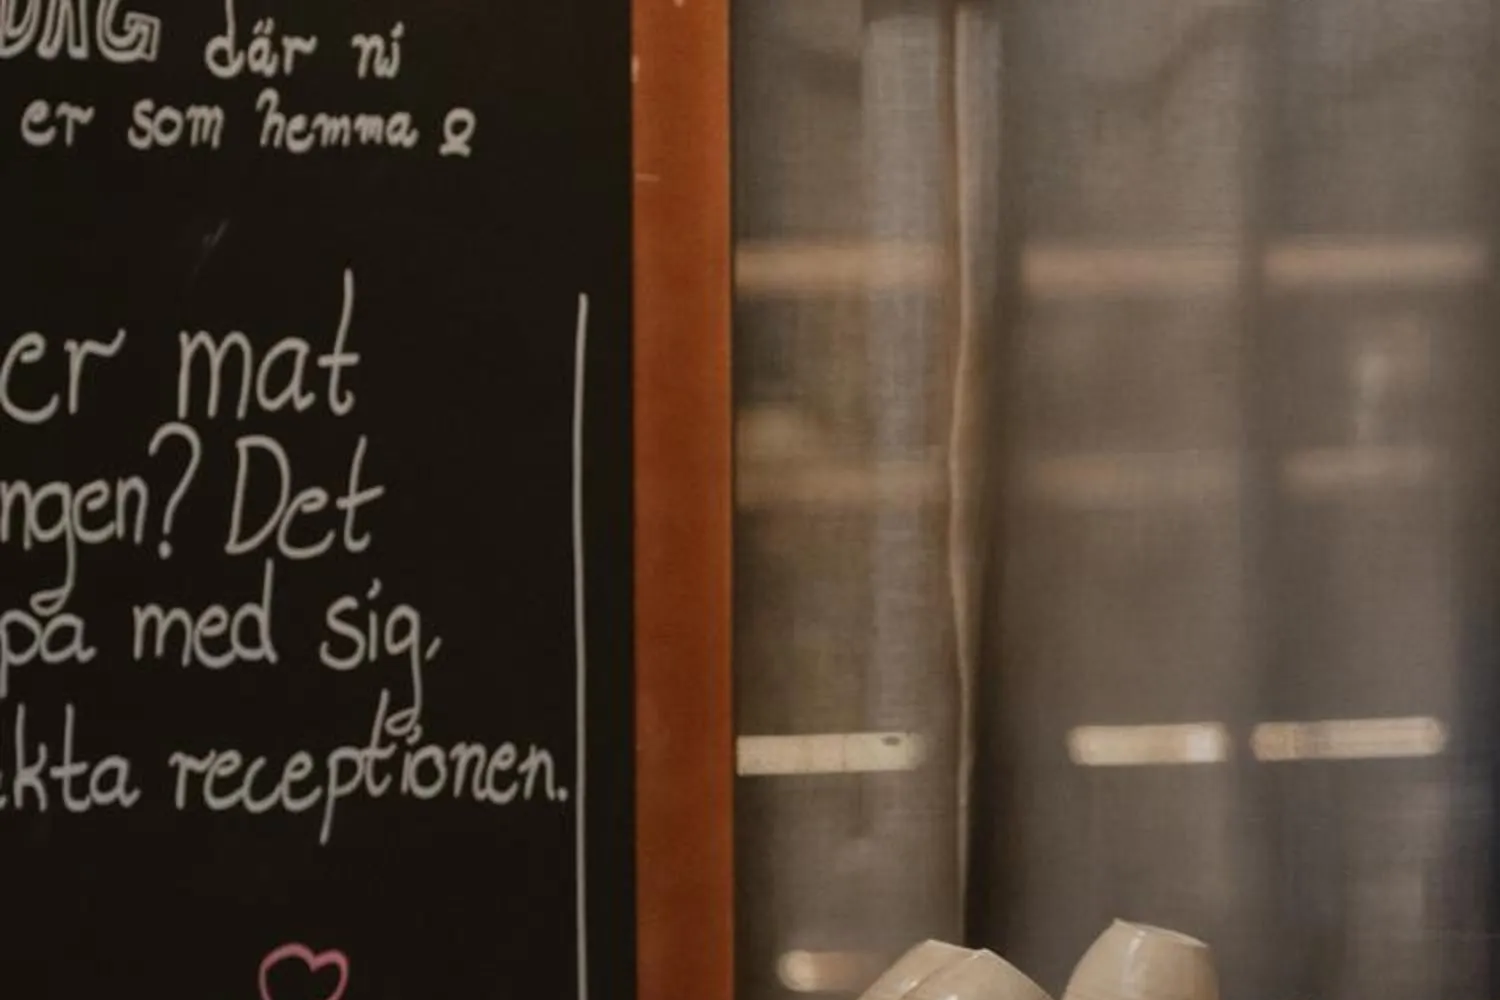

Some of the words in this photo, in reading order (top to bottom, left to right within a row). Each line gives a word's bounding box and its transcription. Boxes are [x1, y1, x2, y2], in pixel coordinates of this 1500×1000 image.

[205, 0, 318, 79] där
[352, 21, 405, 79] ni
[21, 99, 94, 146] er
[128, 98, 224, 150] som
[256, 87, 419, 153] hemma
[0, 329, 126, 423] er
[178, 268, 360, 419] mat
[225, 436, 384, 558] Det
[133, 559, 278, 668] med
[320, 578, 441, 737] sig,
[0, 704, 140, 812] kta
[169, 689, 569, 844] receptionen.
